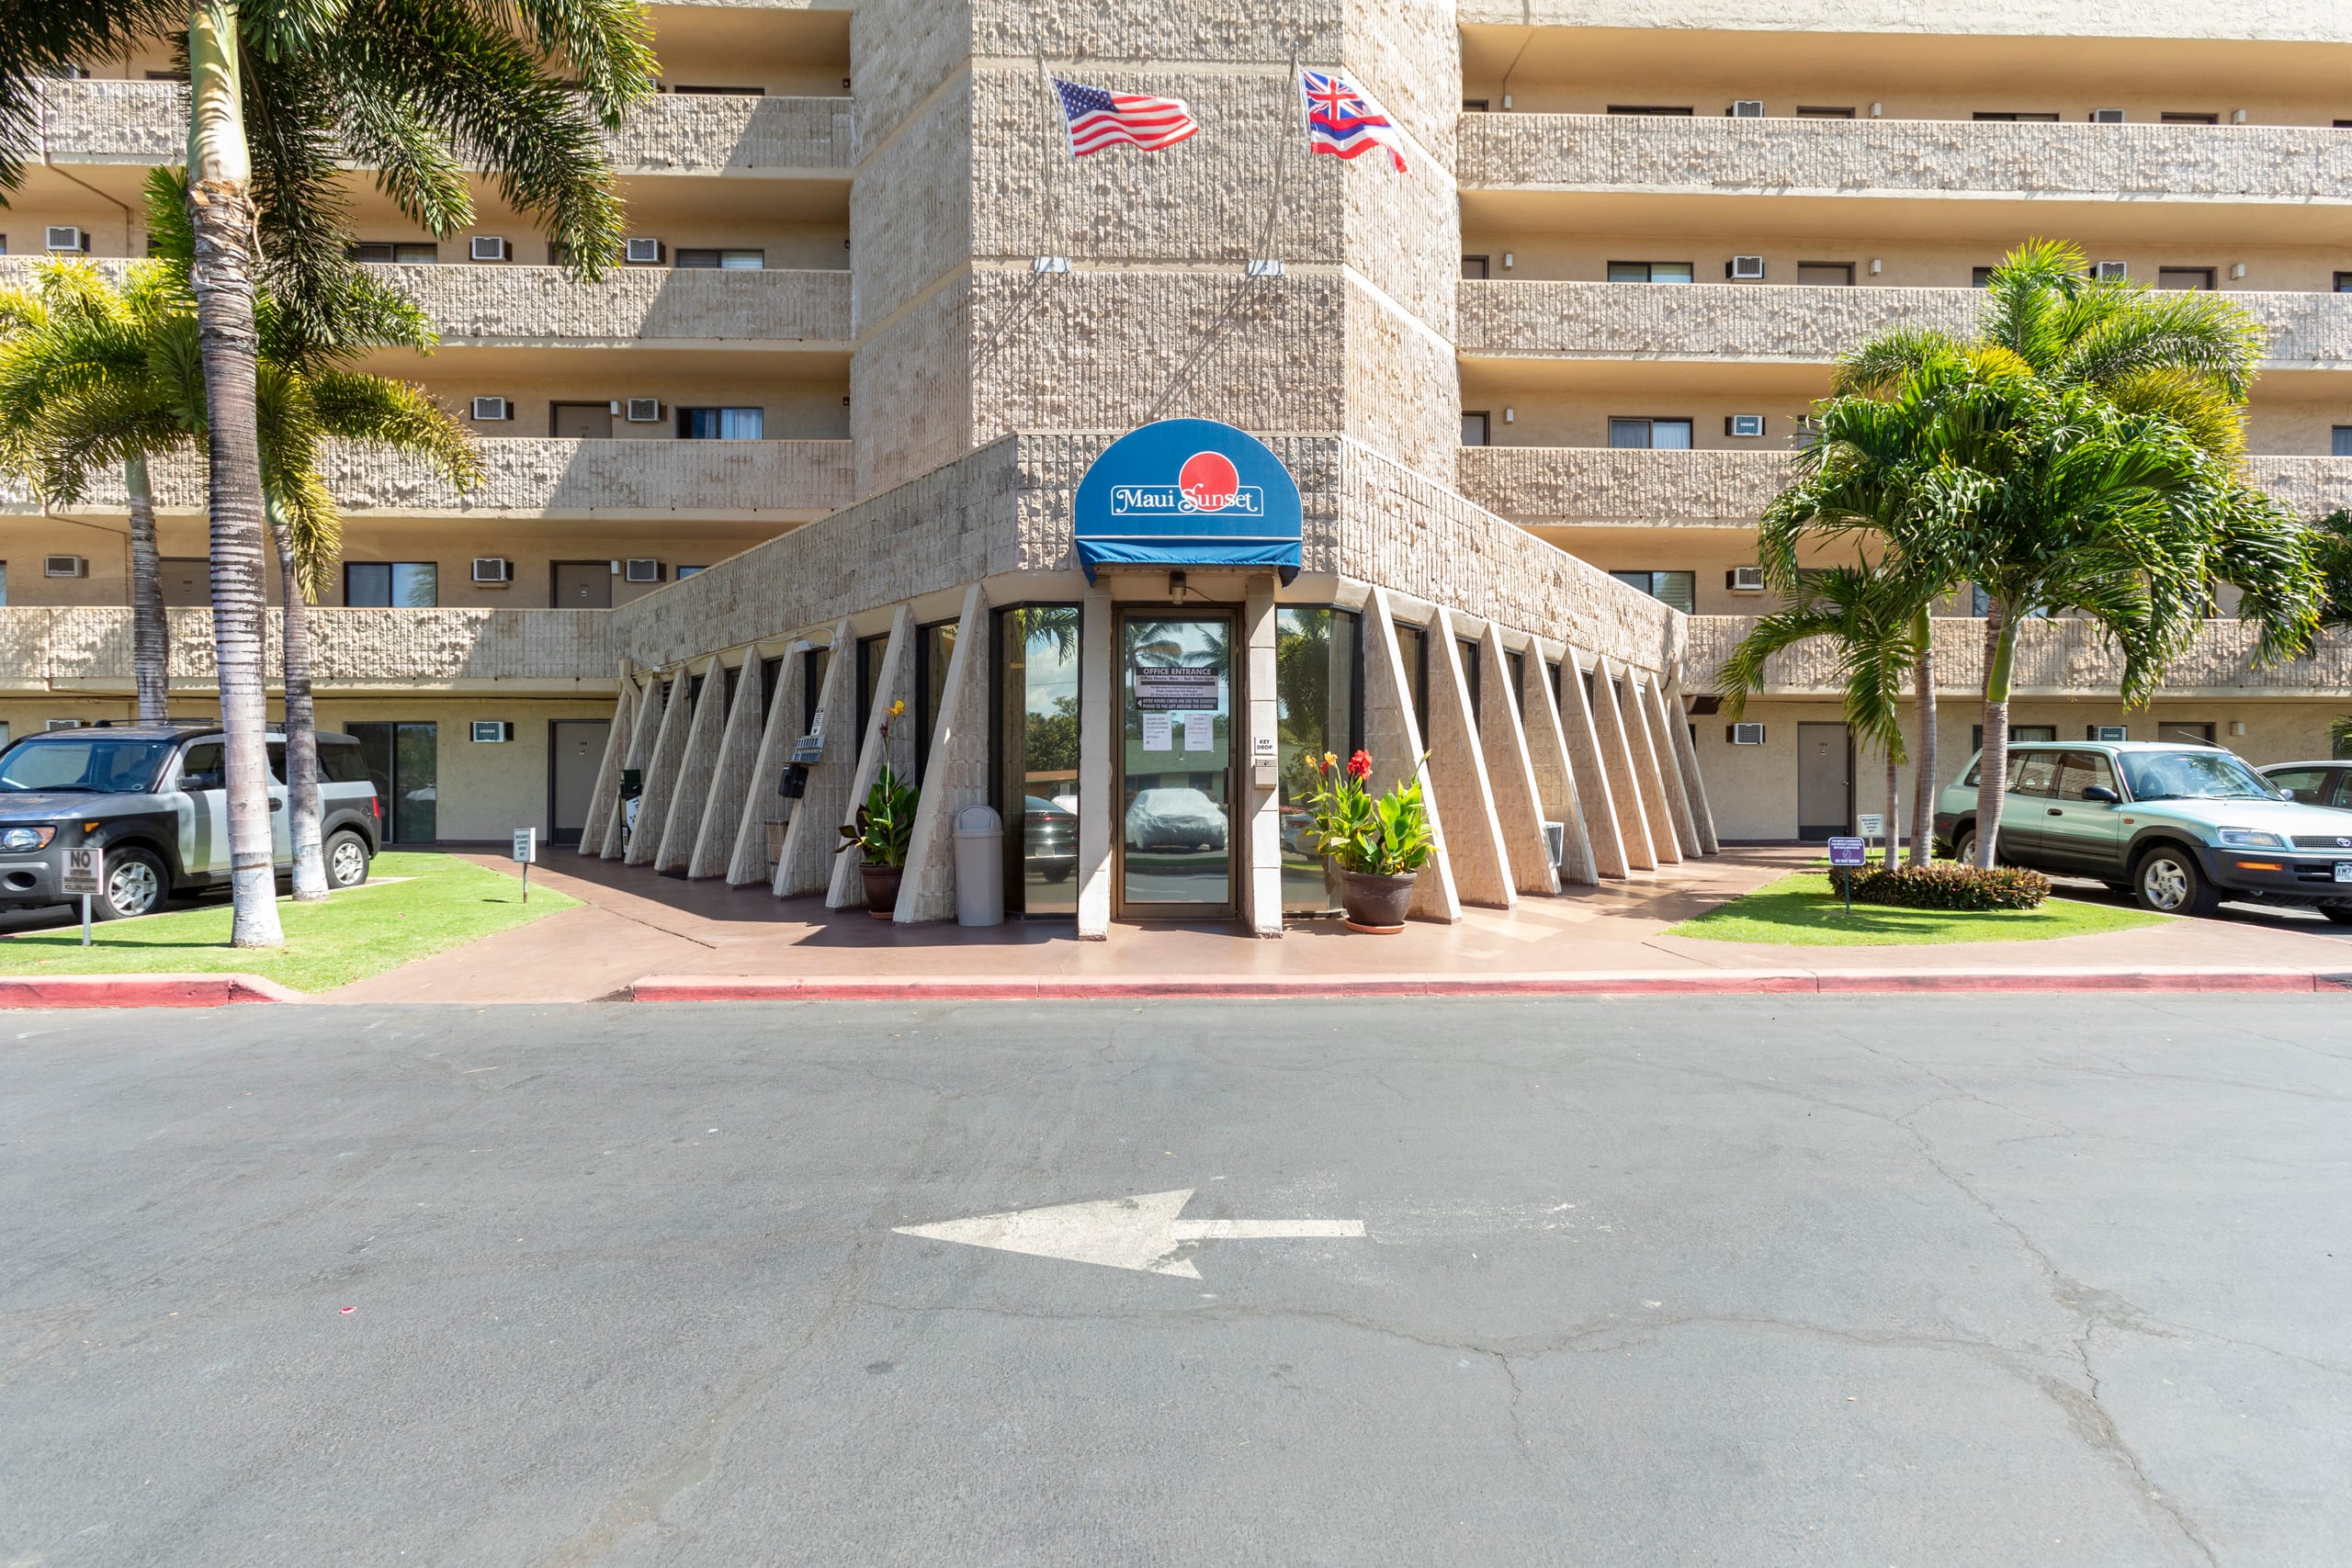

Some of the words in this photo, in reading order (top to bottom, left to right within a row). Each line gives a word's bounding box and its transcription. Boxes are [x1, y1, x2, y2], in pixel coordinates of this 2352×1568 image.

[1115, 489, 1175, 513] Maui
[1178, 483, 1258, 513] Sunset
[71, 851, 91, 868] NO
